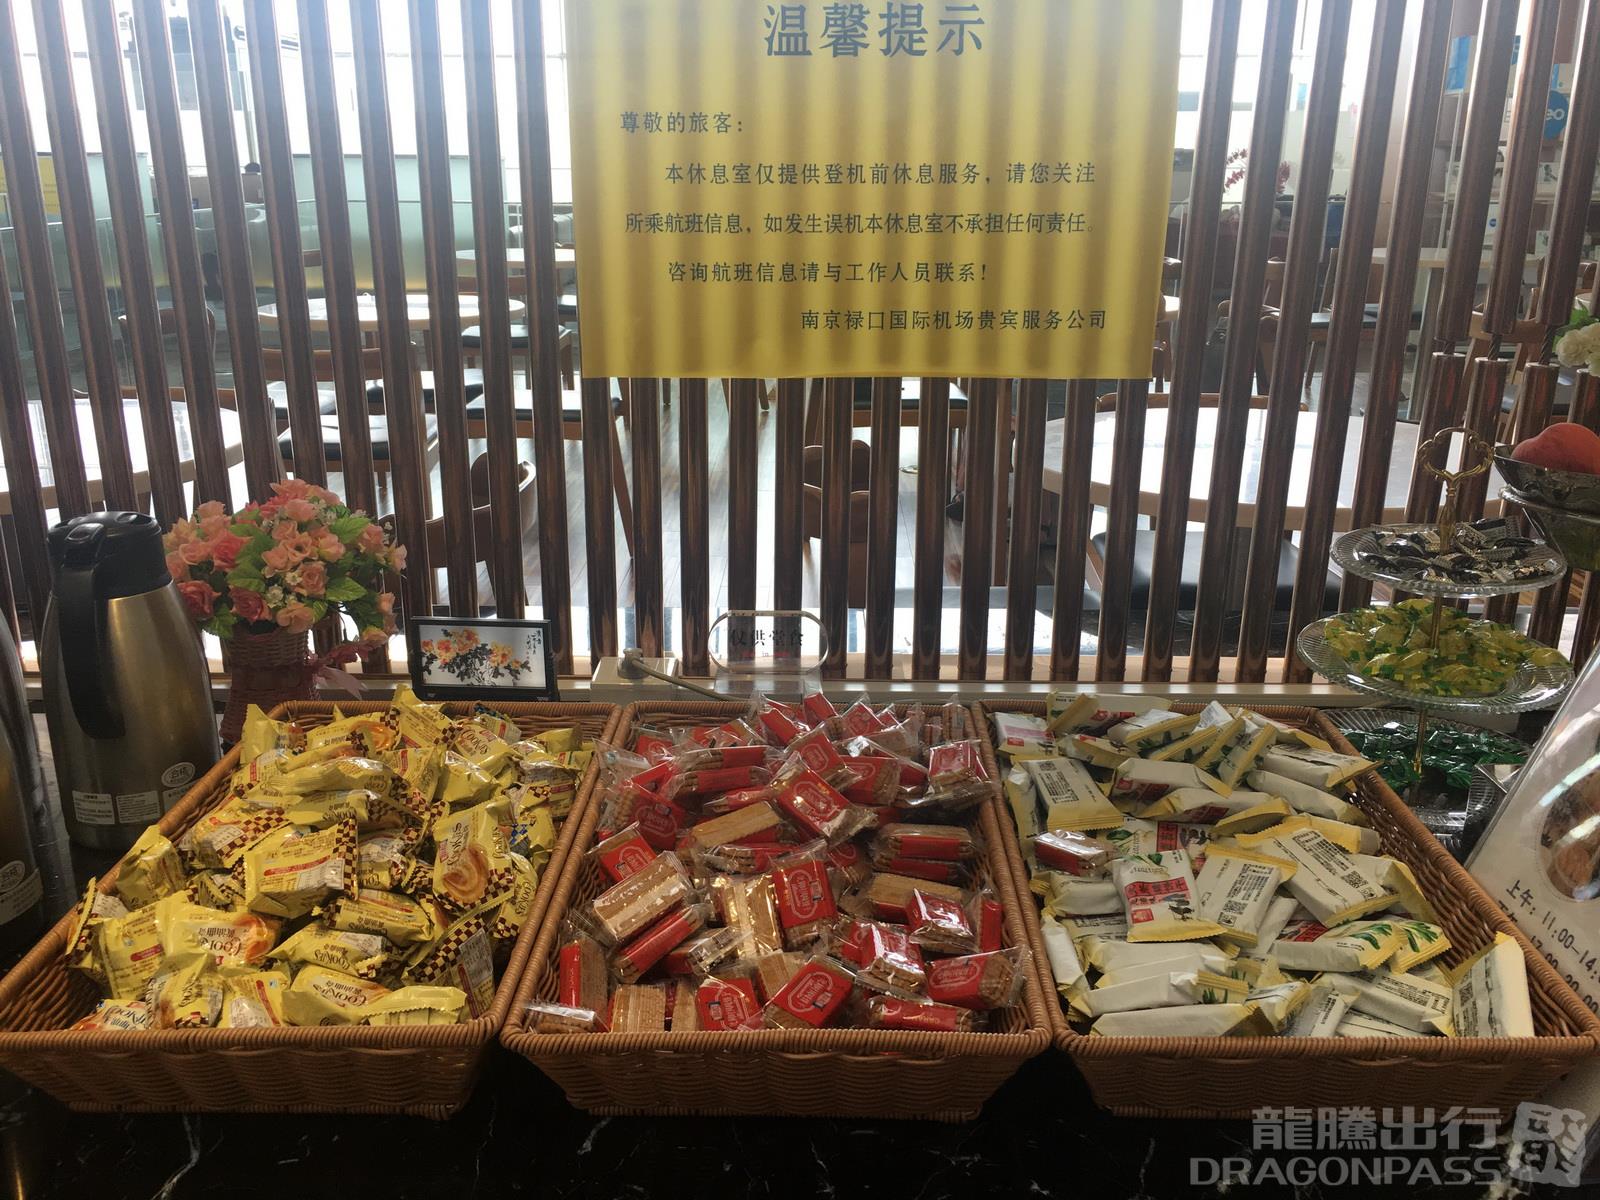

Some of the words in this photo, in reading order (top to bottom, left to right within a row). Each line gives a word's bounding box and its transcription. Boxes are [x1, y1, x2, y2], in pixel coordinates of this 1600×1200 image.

[763, 2, 985, 58] 温馨提示
[620, 111, 744, 133] 尊敬的旅客：
[668, 260, 987, 283] 咨询航班信息请与工作人员联系！
[801, 309, 1107, 331] 南京禄口国际机场贵宾服务公司
